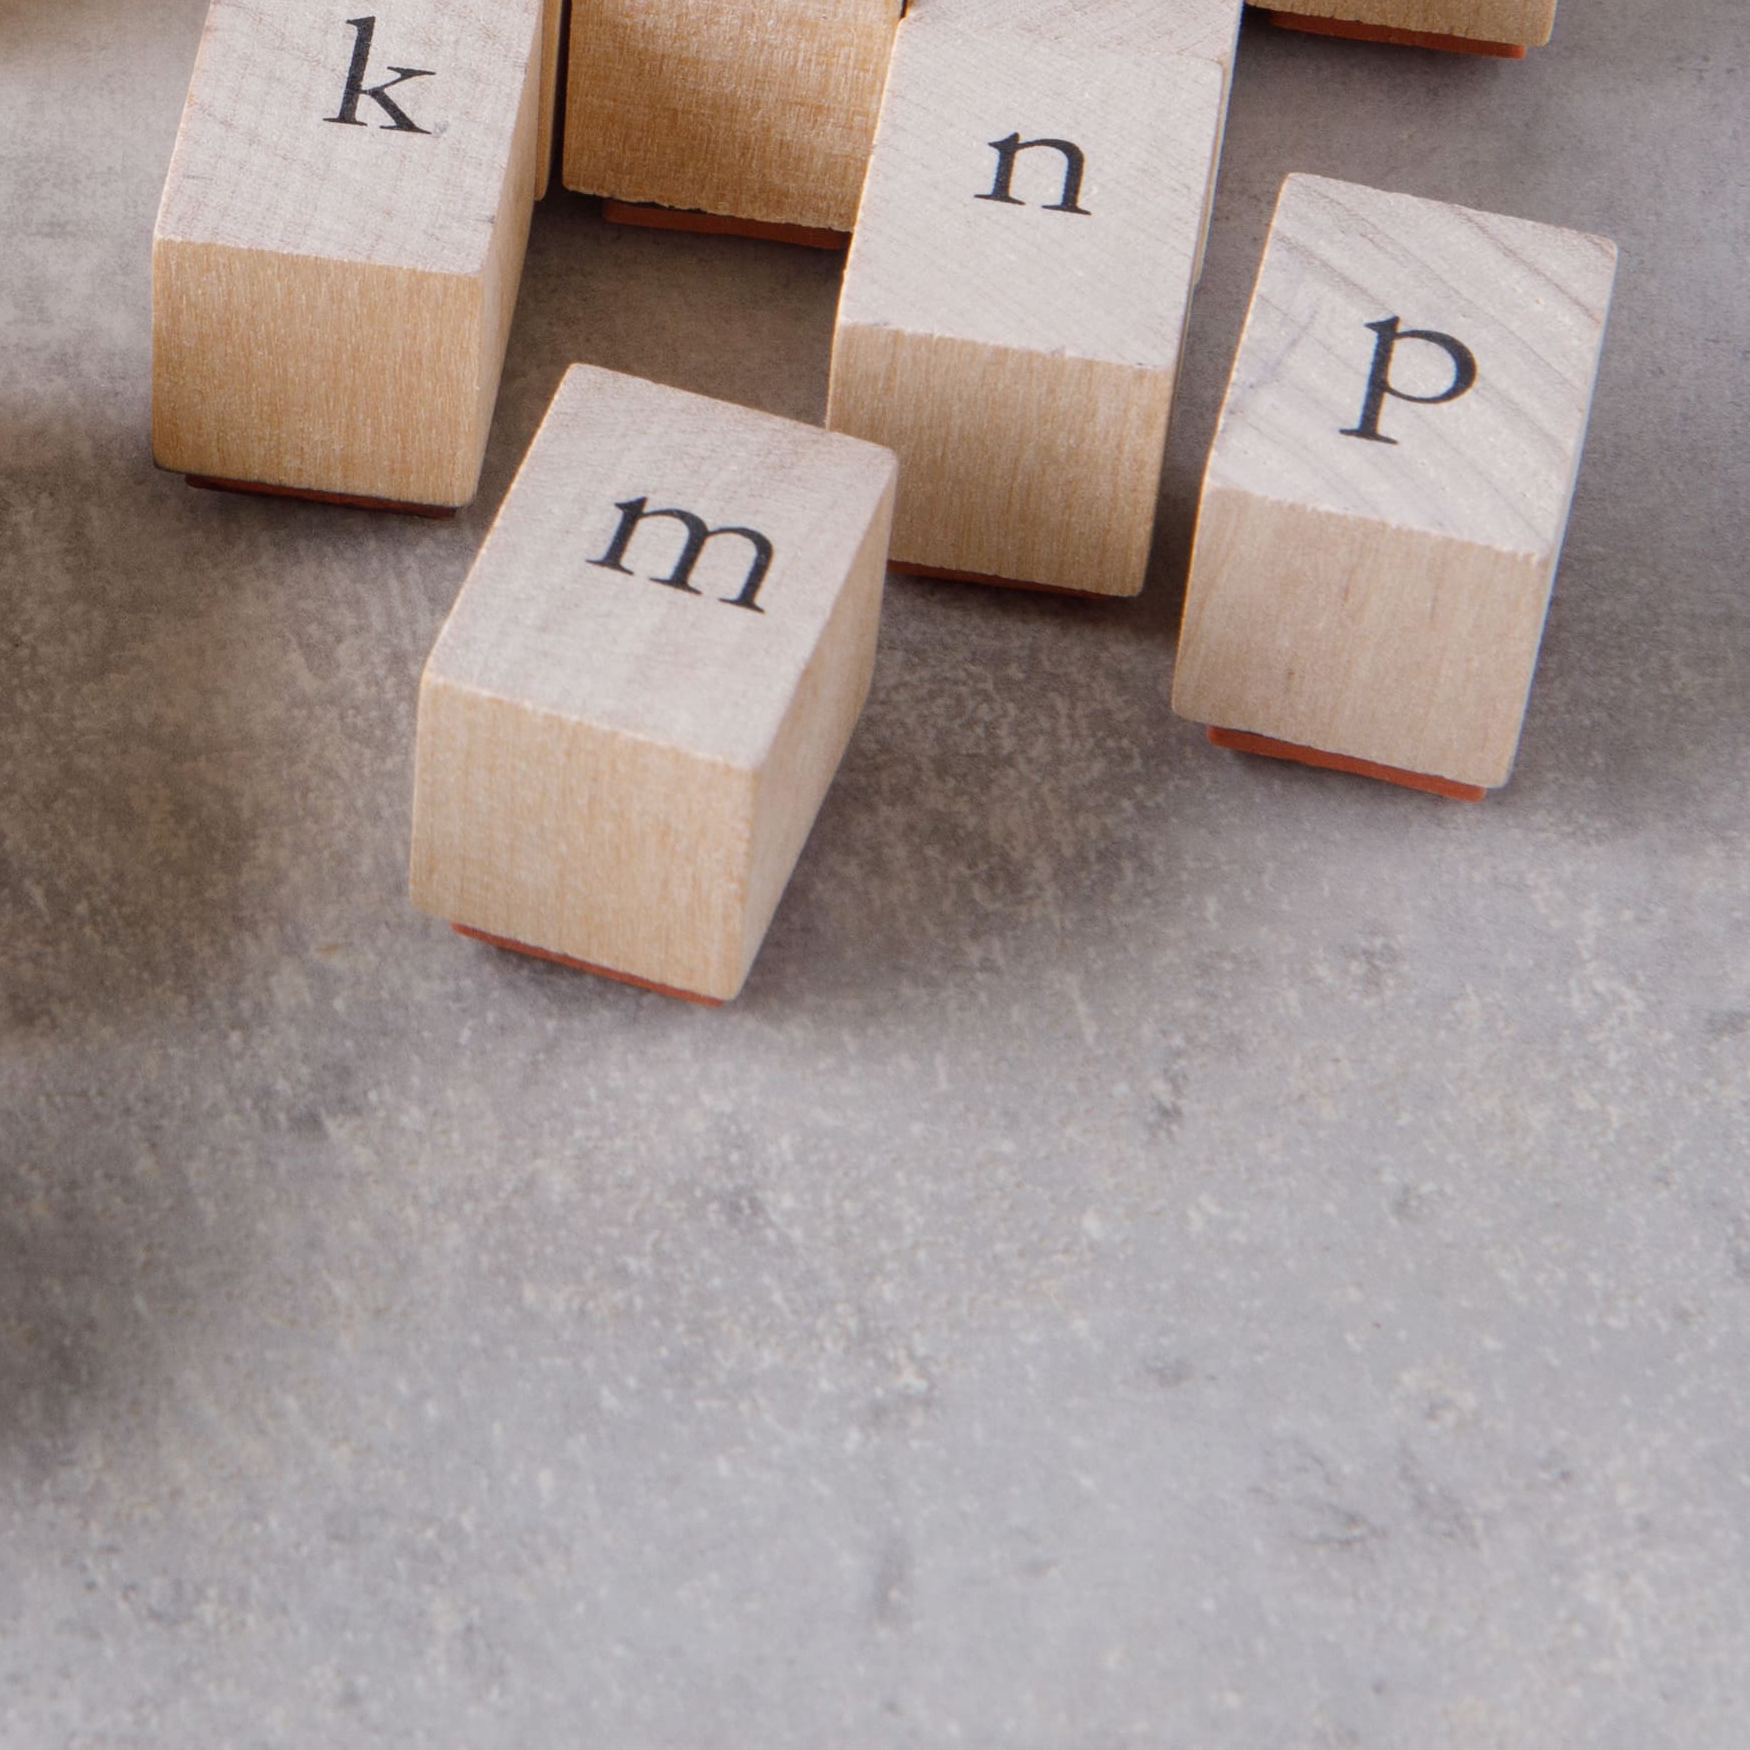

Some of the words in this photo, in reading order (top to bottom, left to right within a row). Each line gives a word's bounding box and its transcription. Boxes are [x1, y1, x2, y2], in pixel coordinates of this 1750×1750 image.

[324, 16, 435, 134] k
[975, 133, 1090, 215] n
[1340, 316, 1476, 444] p
[588, 497, 773, 613] m
